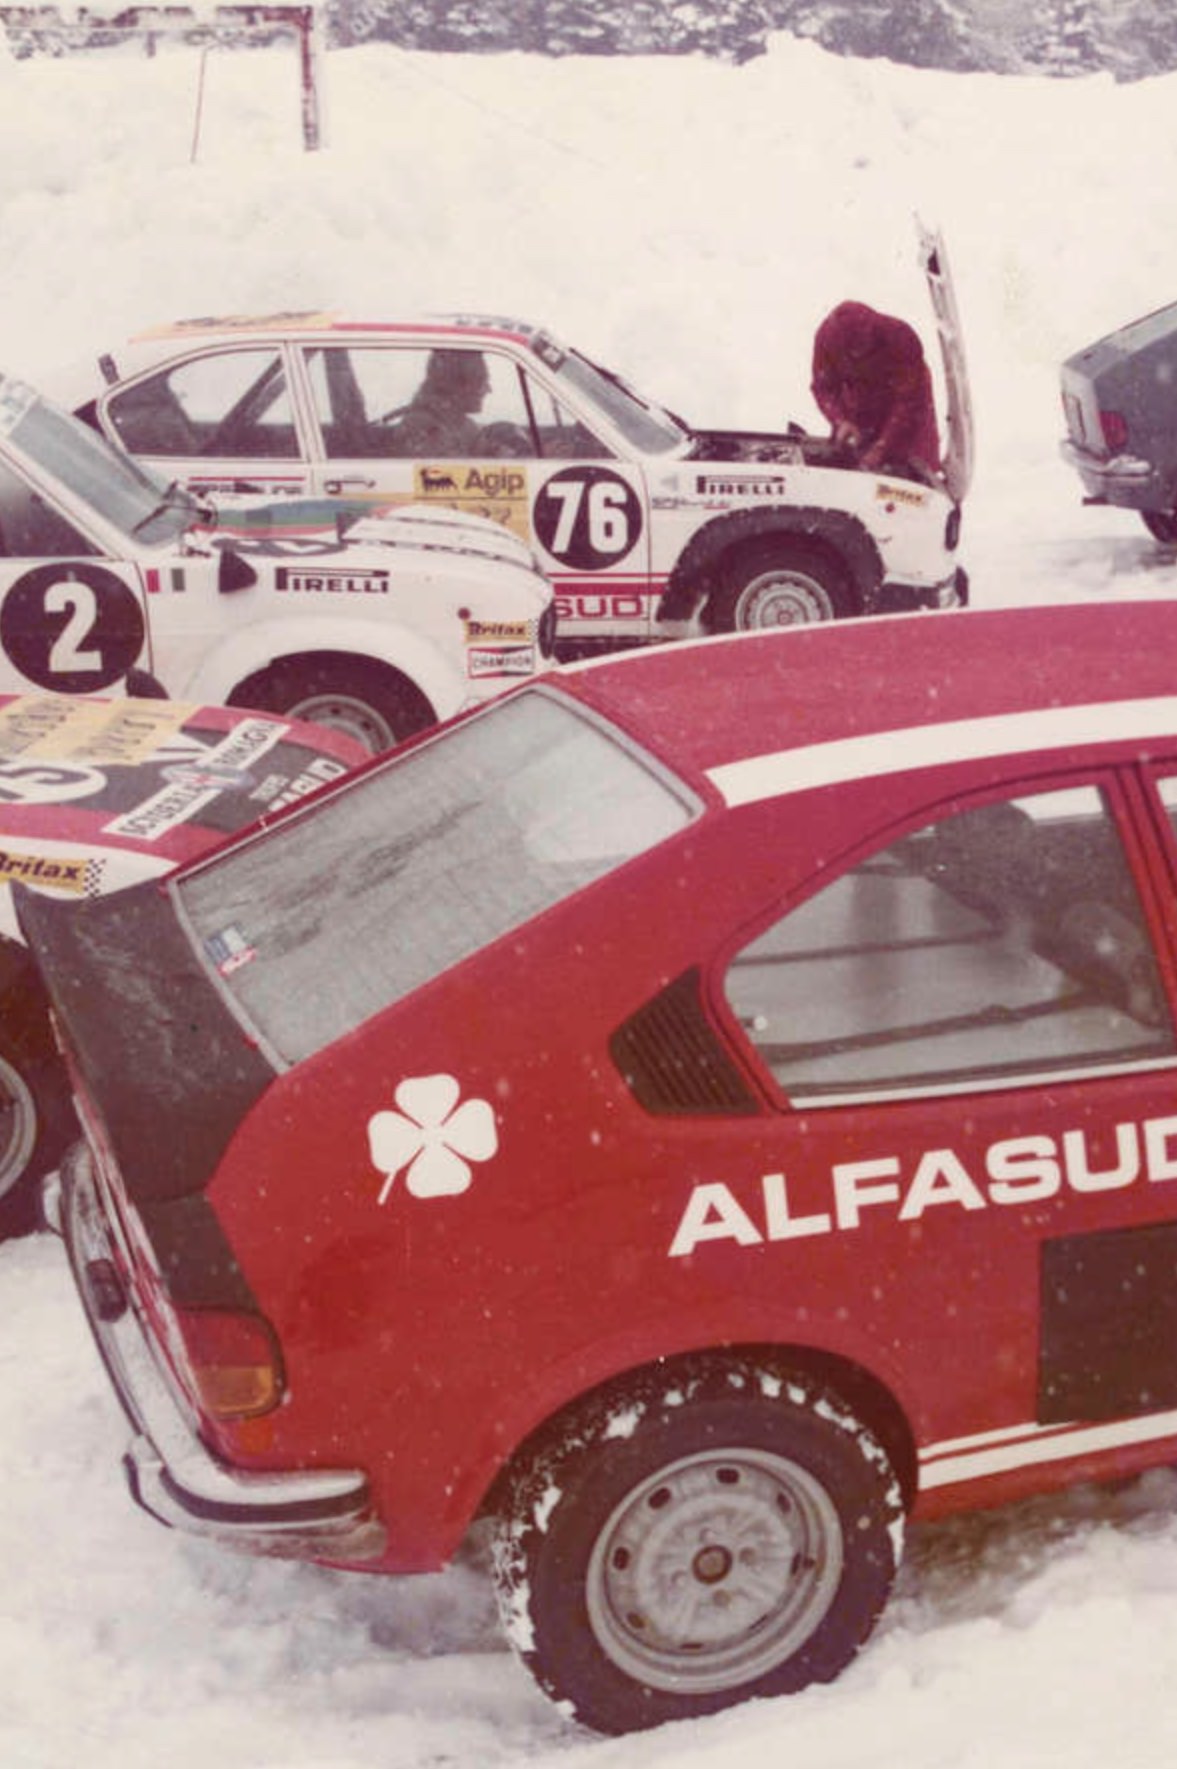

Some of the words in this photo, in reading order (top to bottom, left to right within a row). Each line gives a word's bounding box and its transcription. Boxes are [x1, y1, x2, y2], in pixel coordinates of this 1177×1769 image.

[464, 469, 525, 495] Agip
[696, 475, 785, 494] PIRELLI
[547, 481, 628, 553] 76
[275, 566, 390, 593] PIRELLI
[554, 598, 642, 617] SUD
[44, 581, 103, 672] 2
[468, 621, 526, 636] Britax
